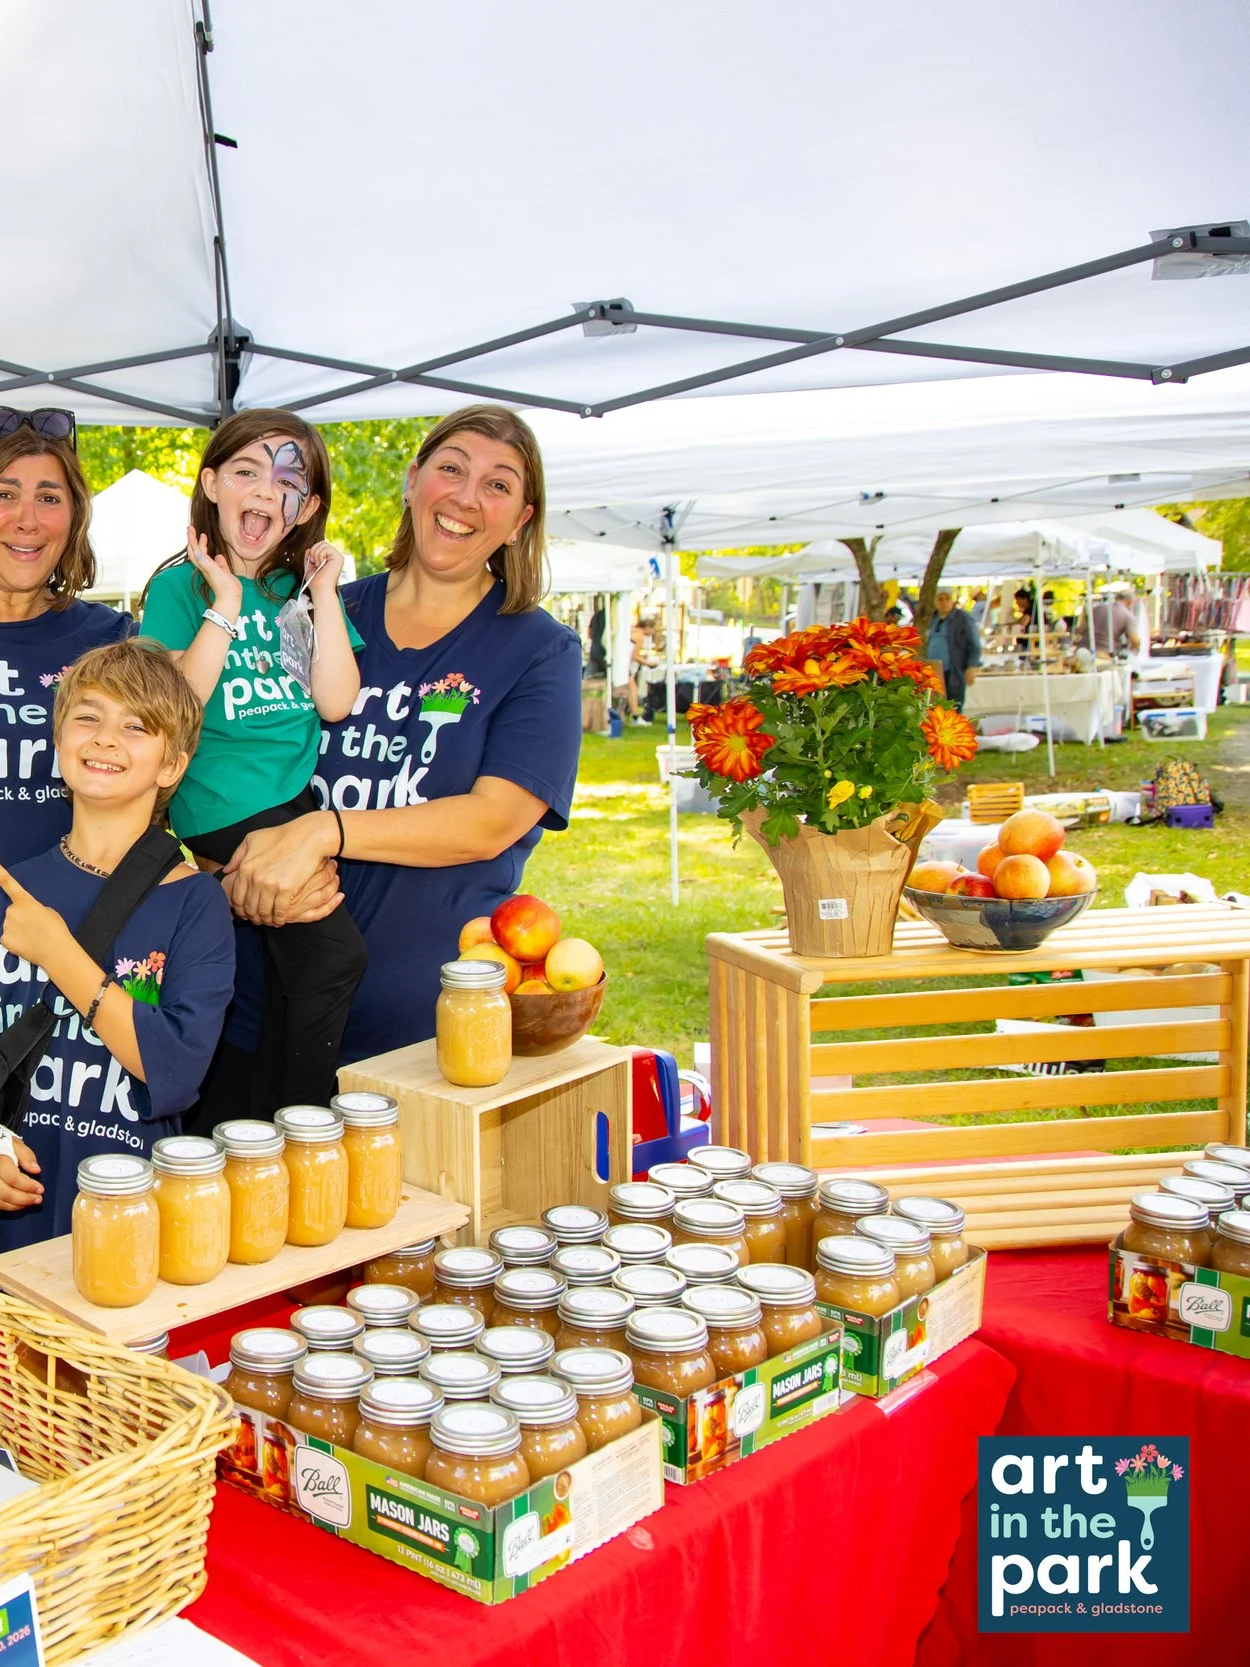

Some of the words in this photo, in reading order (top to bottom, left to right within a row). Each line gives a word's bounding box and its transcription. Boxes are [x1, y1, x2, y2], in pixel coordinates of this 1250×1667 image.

[234, 609, 273, 641] rt
[222, 676, 311, 721] par
[238, 701, 291, 720] peapack
[350, 680, 413, 721] rt
[341, 723, 408, 762] the
[17, 788, 32, 801] &
[29, 1054, 140, 1122] ark
[64, 1116, 76, 1130] &
[1186, 1295, 1225, 1314] Ball
[773, 1372, 802, 1399] MASON
[802, 1362, 823, 1385] JARS
[301, 1467, 343, 1497] Ball
[370, 1493, 415, 1527] MASON
[417, 1513, 450, 1542] JARS
[397, 1545, 406, 1556] 12
[406, 1548, 423, 1563] PINT
[507, 1525, 534, 1563] Ball
[7, 1624, 31, 1647] 2026
